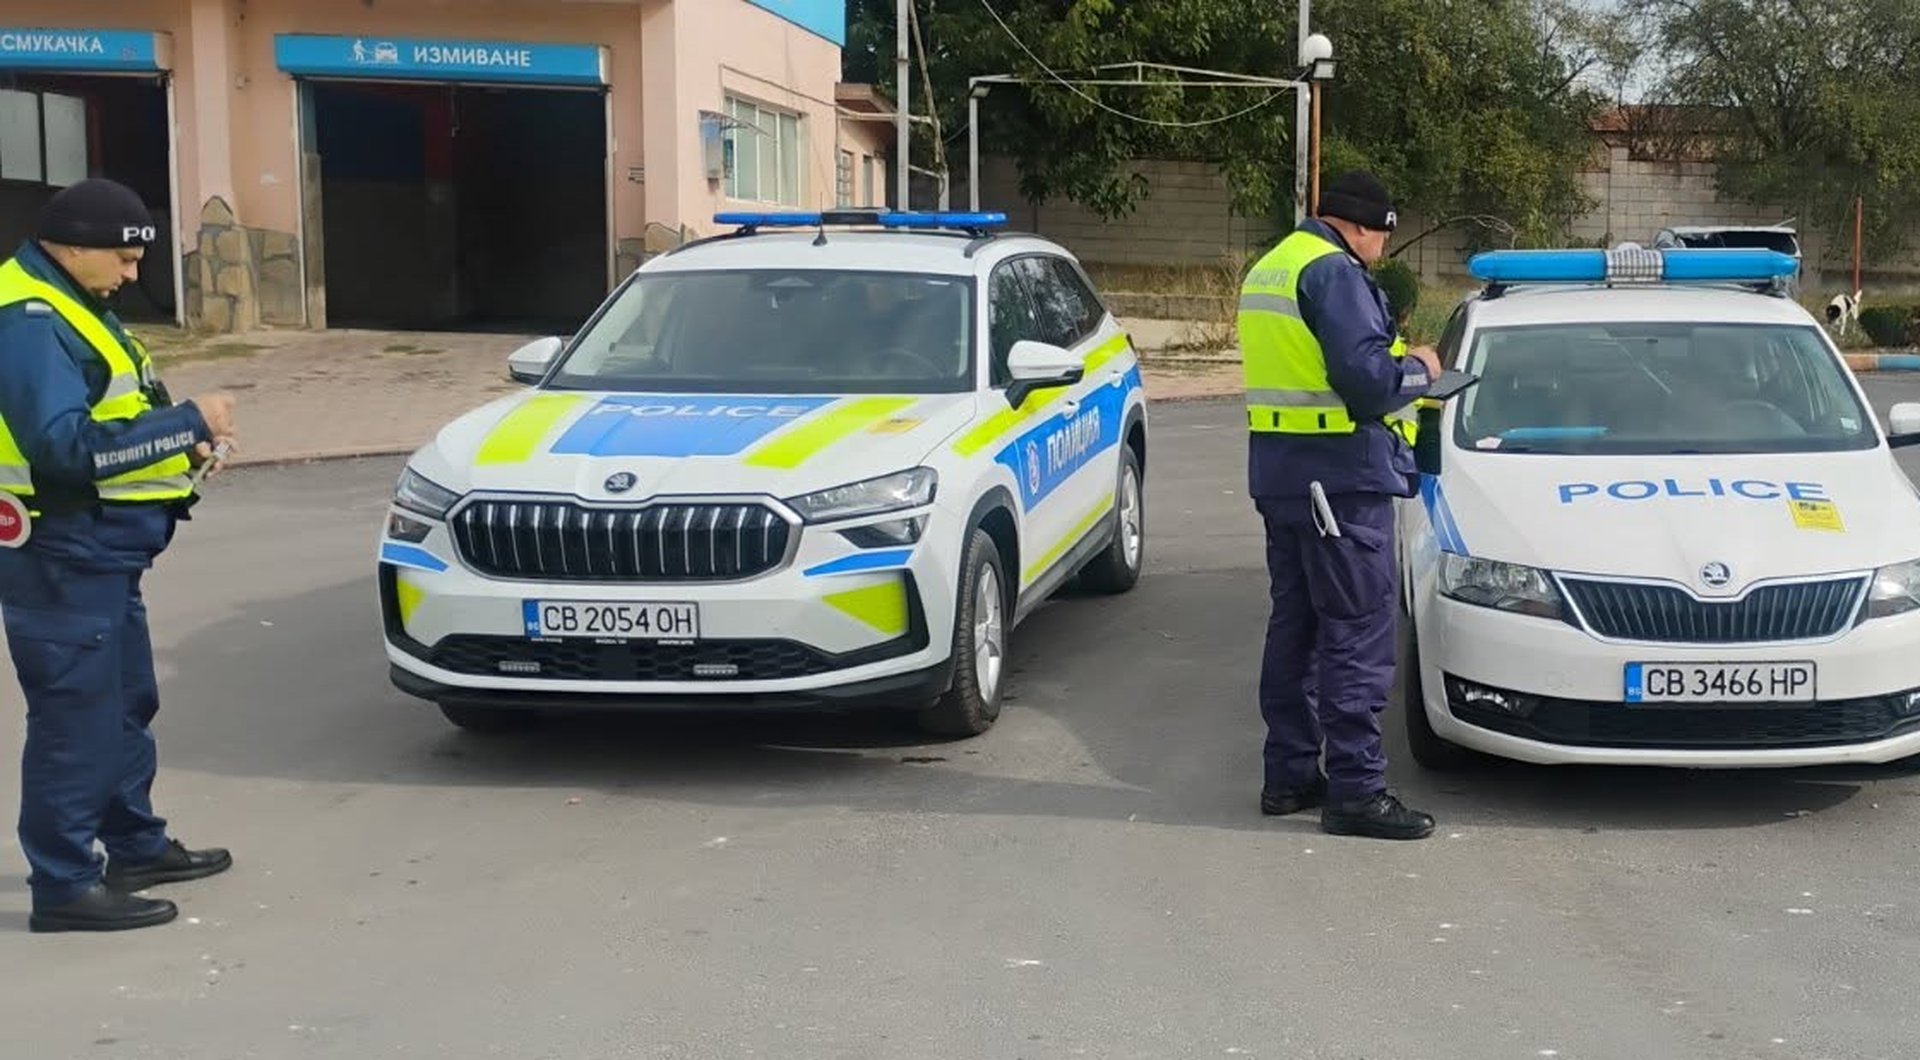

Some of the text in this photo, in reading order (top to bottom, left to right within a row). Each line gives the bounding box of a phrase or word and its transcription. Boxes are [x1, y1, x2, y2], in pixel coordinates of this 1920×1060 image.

[1, 33, 104, 54] СМУКАЧКА
[413, 45, 532, 67] ИЗМИВАНЕ
[591, 404, 809, 417] POLICE
[93, 430, 195, 469] SECURITY POLICE
[1558, 478, 1832, 504] POLICE
[584, 606, 649, 633] 2054
[1691, 668, 1763, 697] 3466
